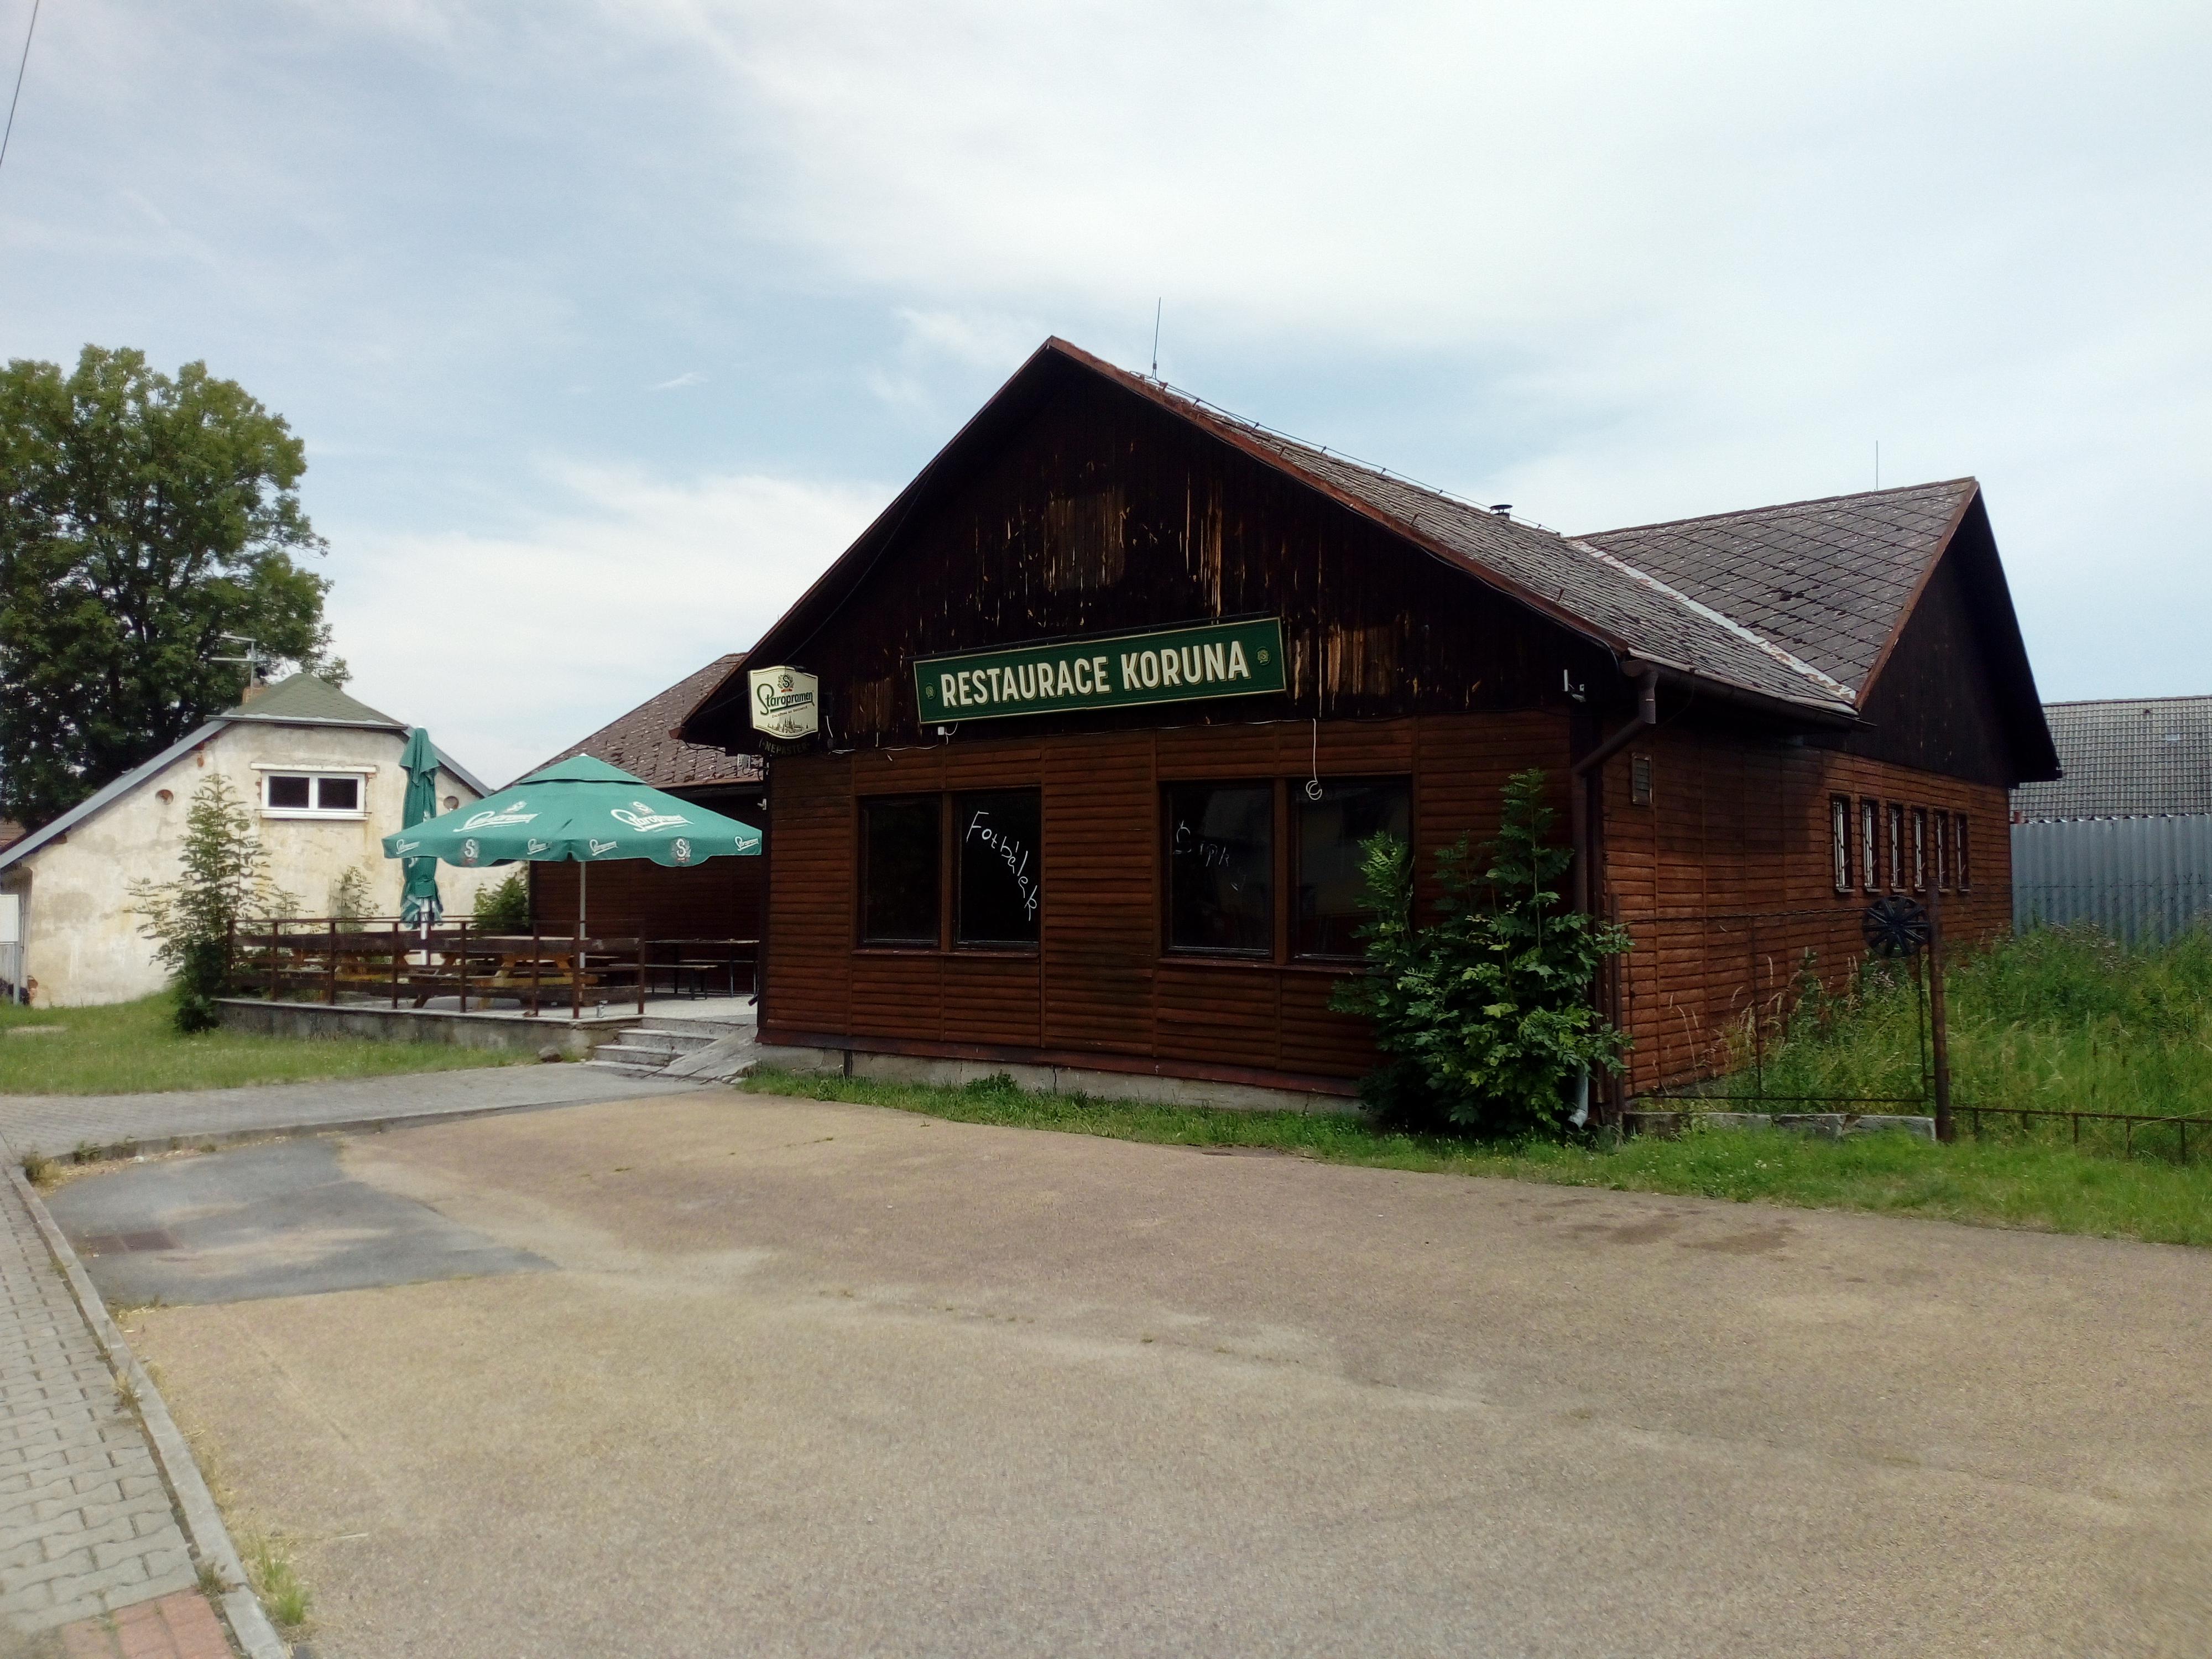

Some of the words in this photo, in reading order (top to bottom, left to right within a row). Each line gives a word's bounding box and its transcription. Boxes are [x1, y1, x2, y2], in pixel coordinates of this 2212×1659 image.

[757, 683, 815, 716] Staropramen
[940, 656, 1112, 708] RESTAURACE
[1121, 640, 1251, 691] KORUNA
[966, 811, 1037, 921] Fotbálek
